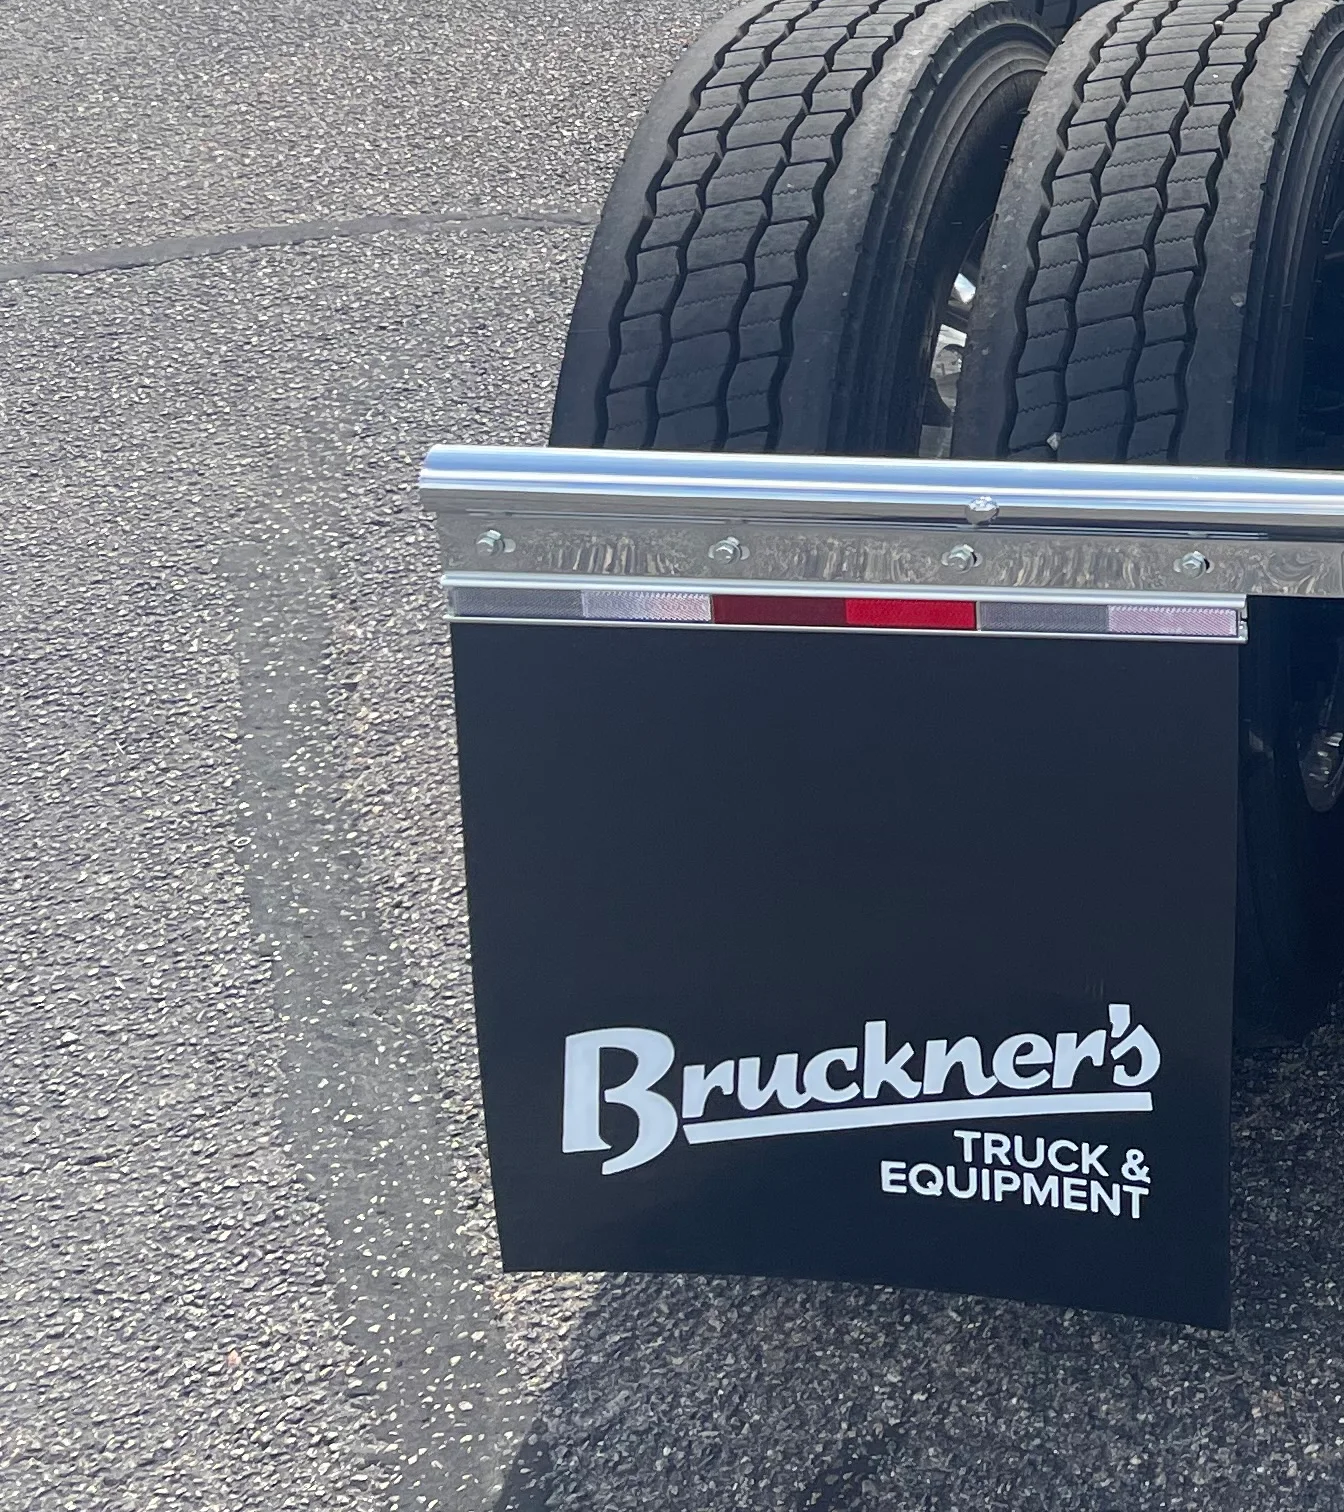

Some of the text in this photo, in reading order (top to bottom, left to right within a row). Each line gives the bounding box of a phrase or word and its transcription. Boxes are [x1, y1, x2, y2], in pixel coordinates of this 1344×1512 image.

[562, 1003, 1161, 1176] Bruckner's
[953, 1129, 1151, 1184] TRUCK &
[880, 1160, 1150, 1219] EQUIPMENT
